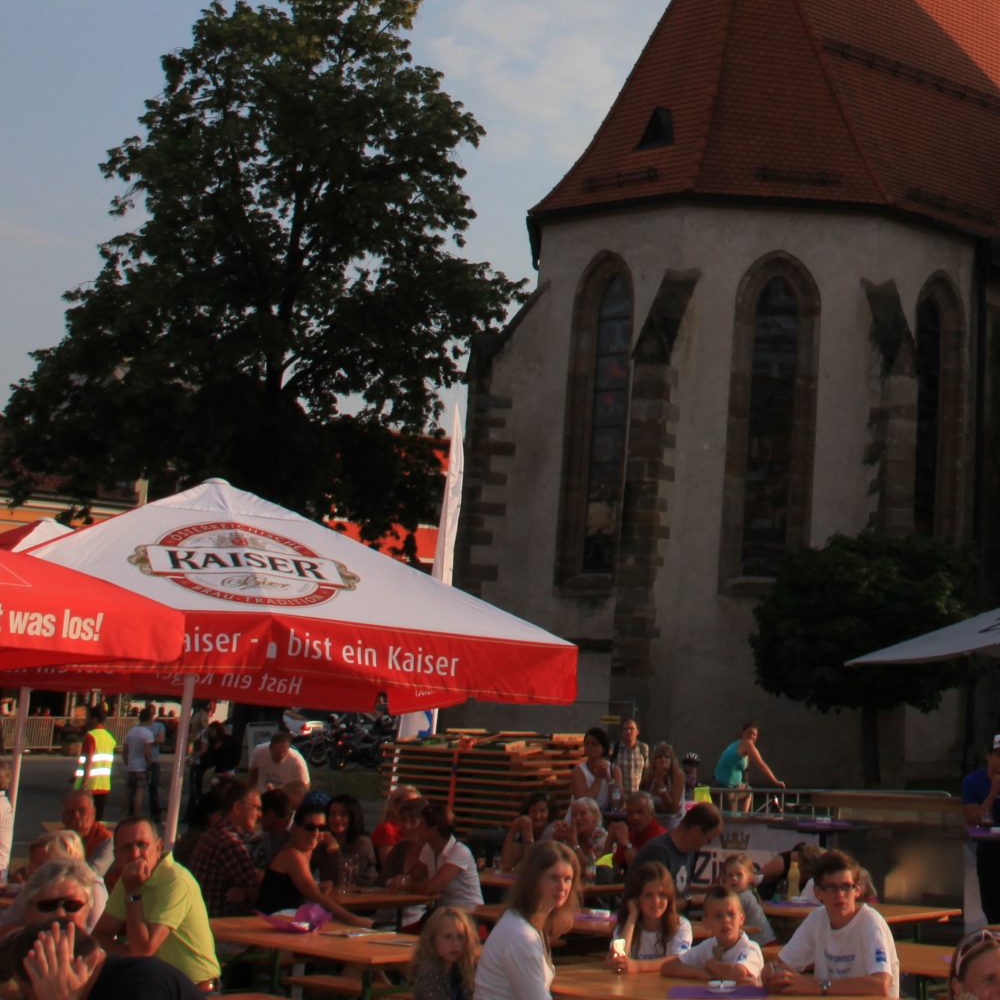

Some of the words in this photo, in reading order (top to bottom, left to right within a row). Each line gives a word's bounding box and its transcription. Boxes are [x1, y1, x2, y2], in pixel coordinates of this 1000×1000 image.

[167, 550, 328, 580] KAISER
[9, 609, 56, 637] was
[62, 608, 104, 641] los!
[184, 626, 242, 653] aiser
[288, 628, 332, 661] bist
[342, 640, 377, 667] ein
[388, 646, 460, 677] Kaiser
